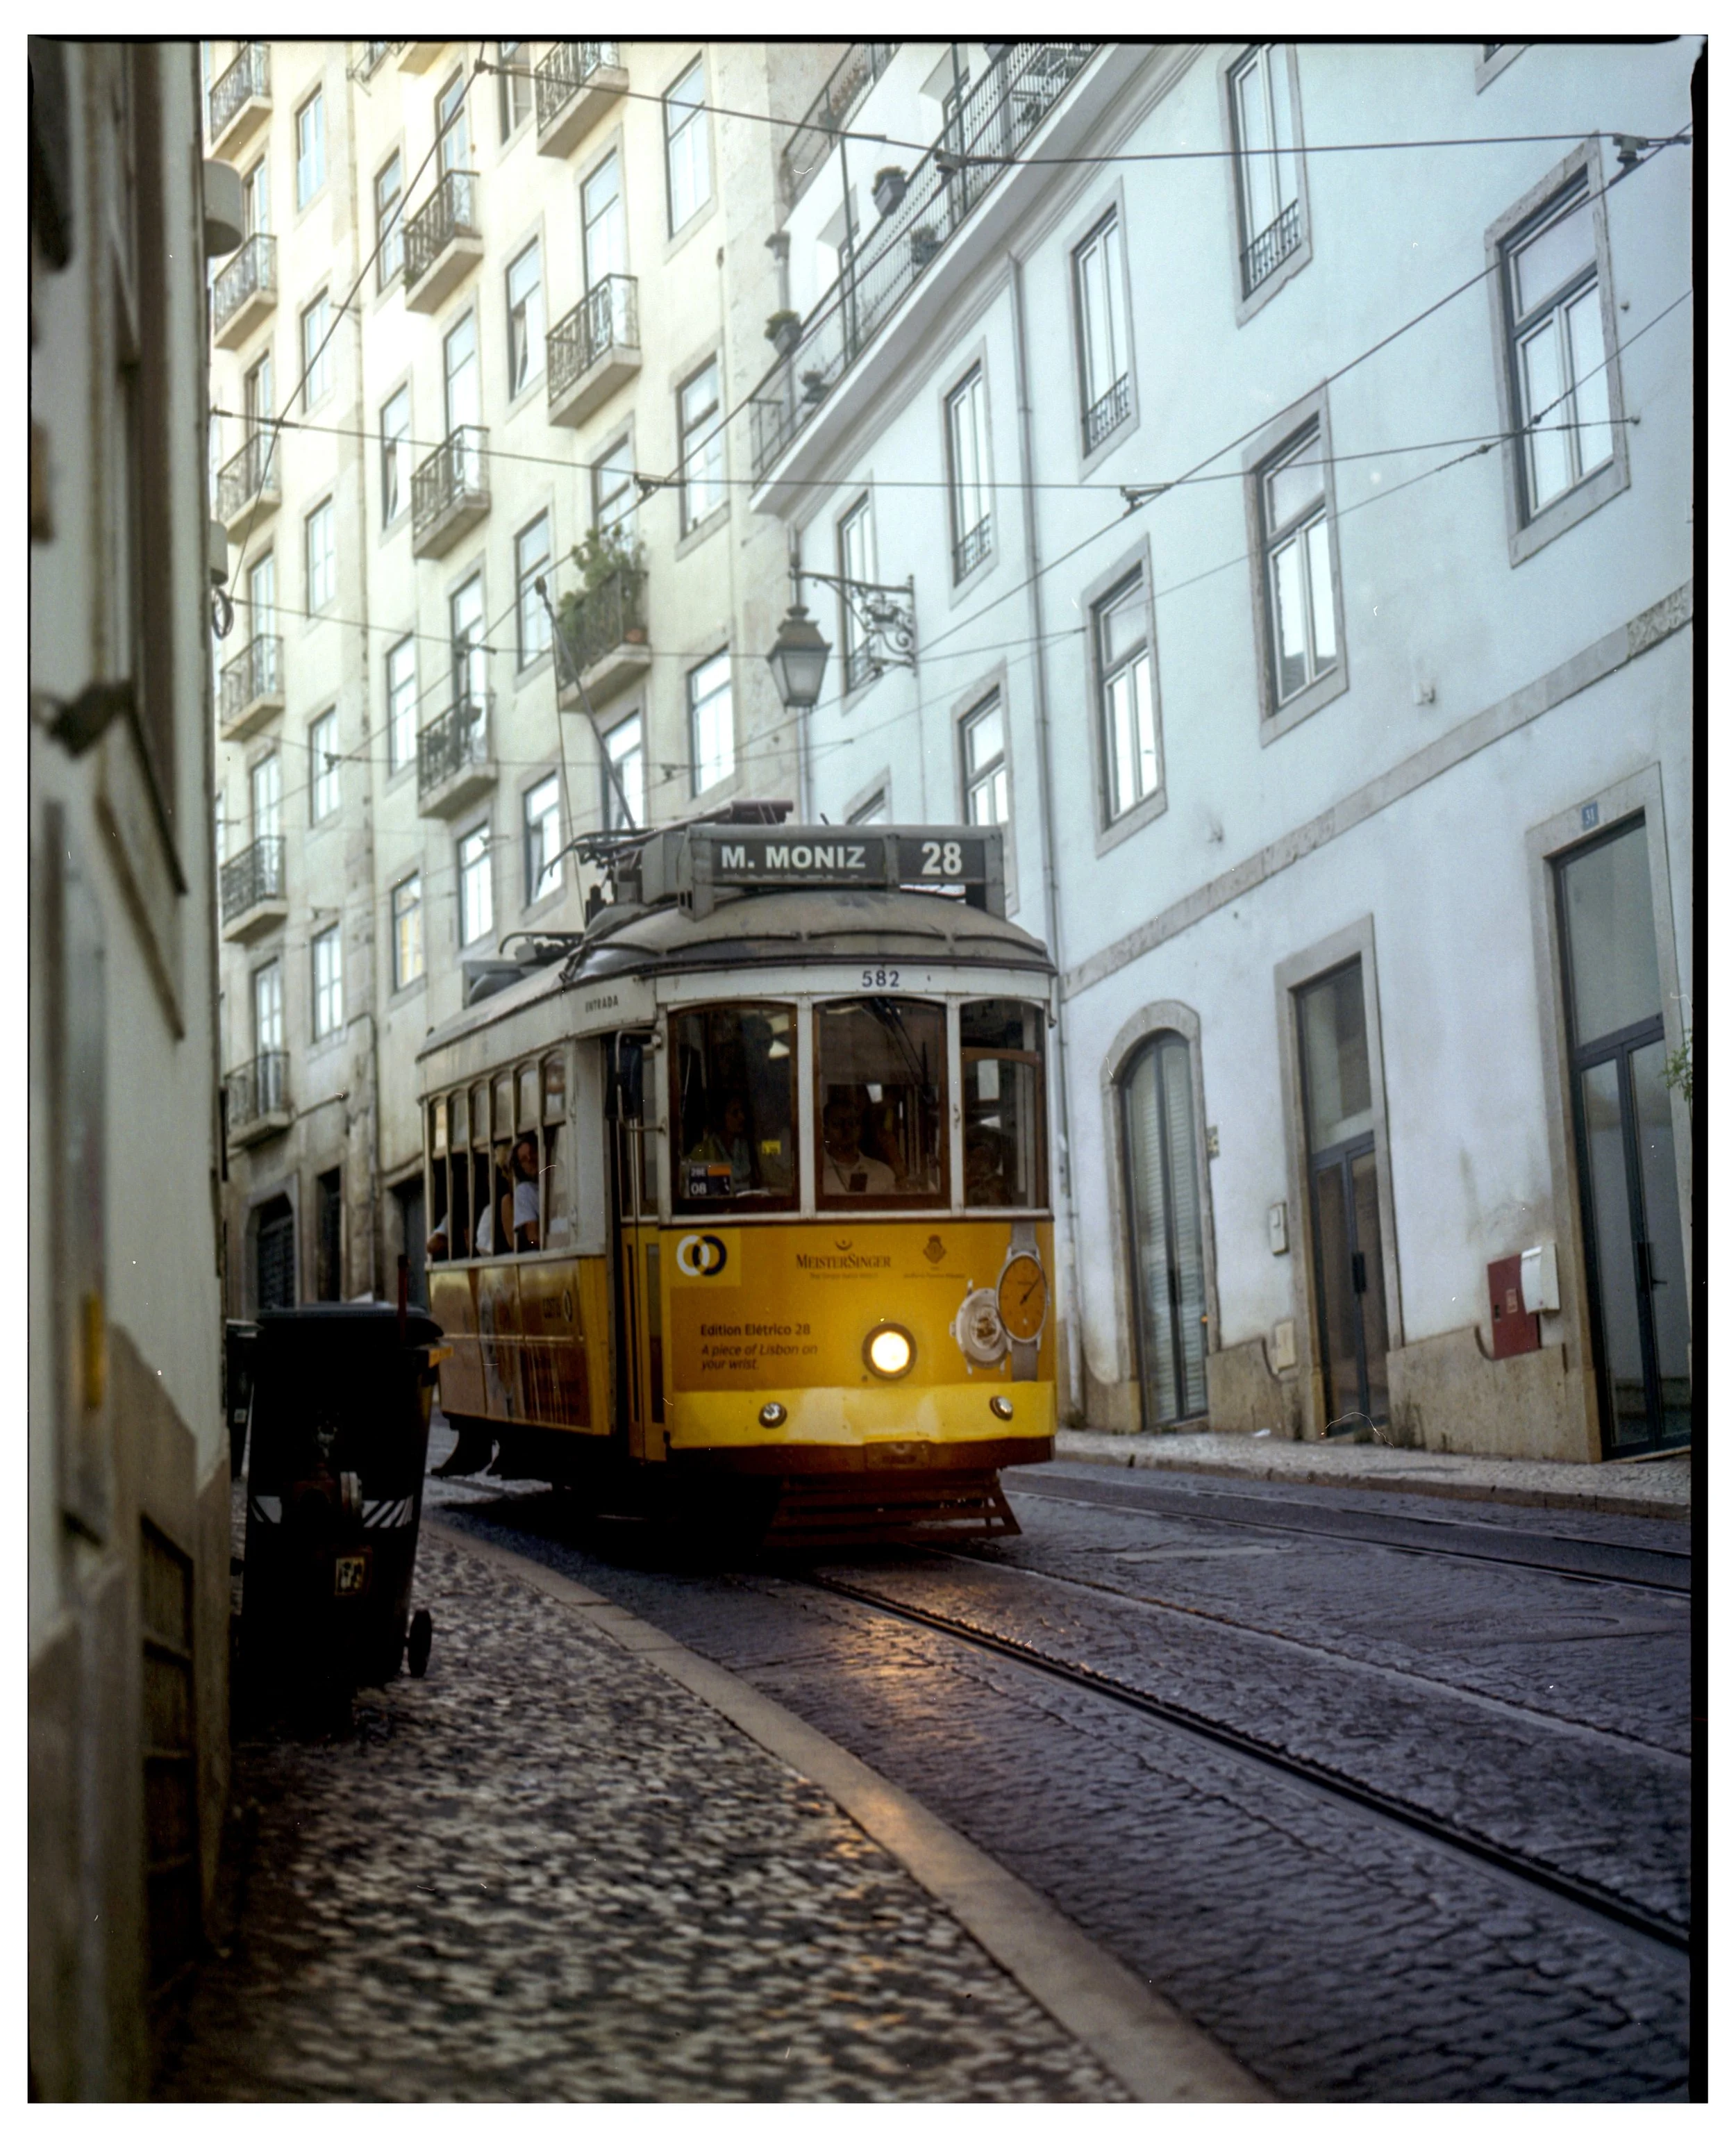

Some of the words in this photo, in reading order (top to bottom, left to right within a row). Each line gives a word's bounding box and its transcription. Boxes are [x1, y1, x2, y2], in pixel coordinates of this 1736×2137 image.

[721, 846, 756, 868] M.
[766, 845, 866, 869] MONIZ
[921, 841, 962, 875] 28
[862, 970, 900, 987] 582
[585, 995, 619, 1013] ENTRADA
[691, 1182, 707, 1195] 08
[700, 1323, 742, 1336] Edition
[745, 1322, 792, 1336] Elétrico
[795, 1322, 811, 1336] 28
[701, 1344, 709, 1355] A
[712, 1344, 742, 1357] piece
[744, 1343, 758, 1356] of
[759, 1343, 799, 1355] Lisbon
[802, 1345, 818, 1355] on
[701, 1359, 726, 1372] your
